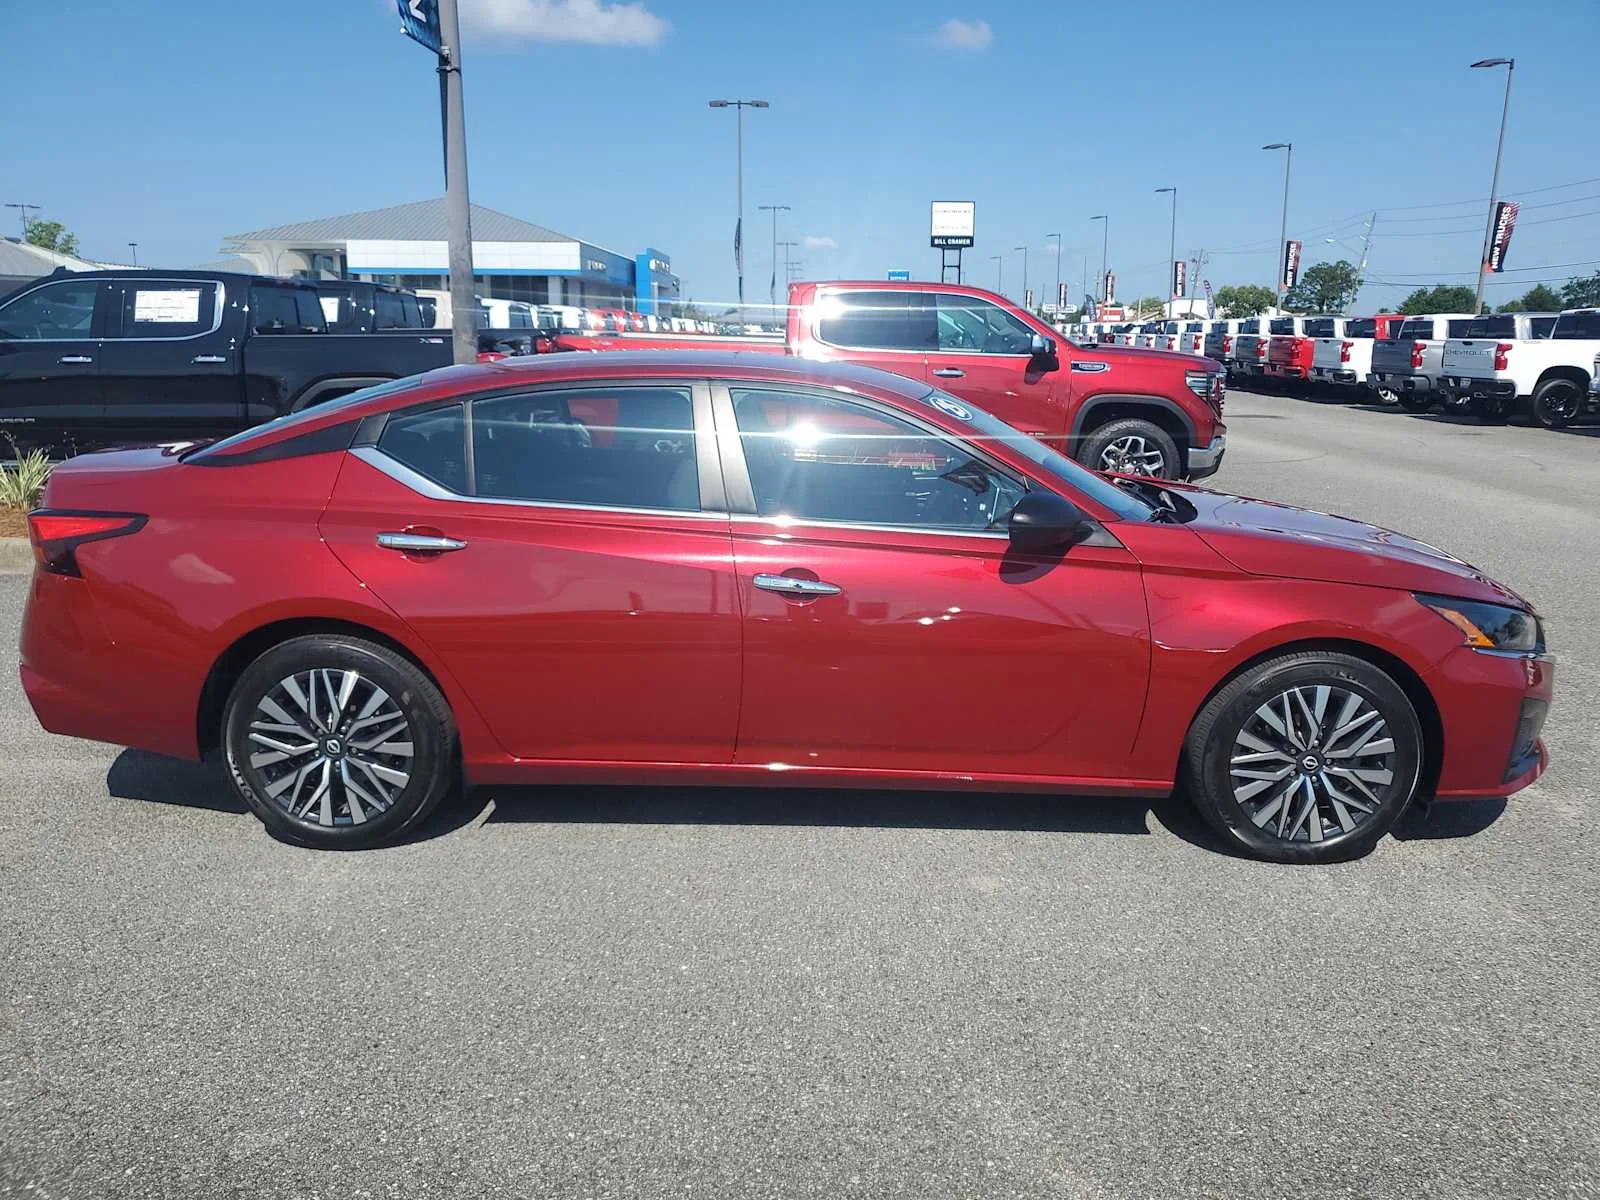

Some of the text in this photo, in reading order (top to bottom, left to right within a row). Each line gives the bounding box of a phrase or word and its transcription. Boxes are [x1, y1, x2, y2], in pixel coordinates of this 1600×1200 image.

[1491, 206, 1511, 269] NEW TRUCKS
[1445, 349, 1490, 357] CHEVROLET
